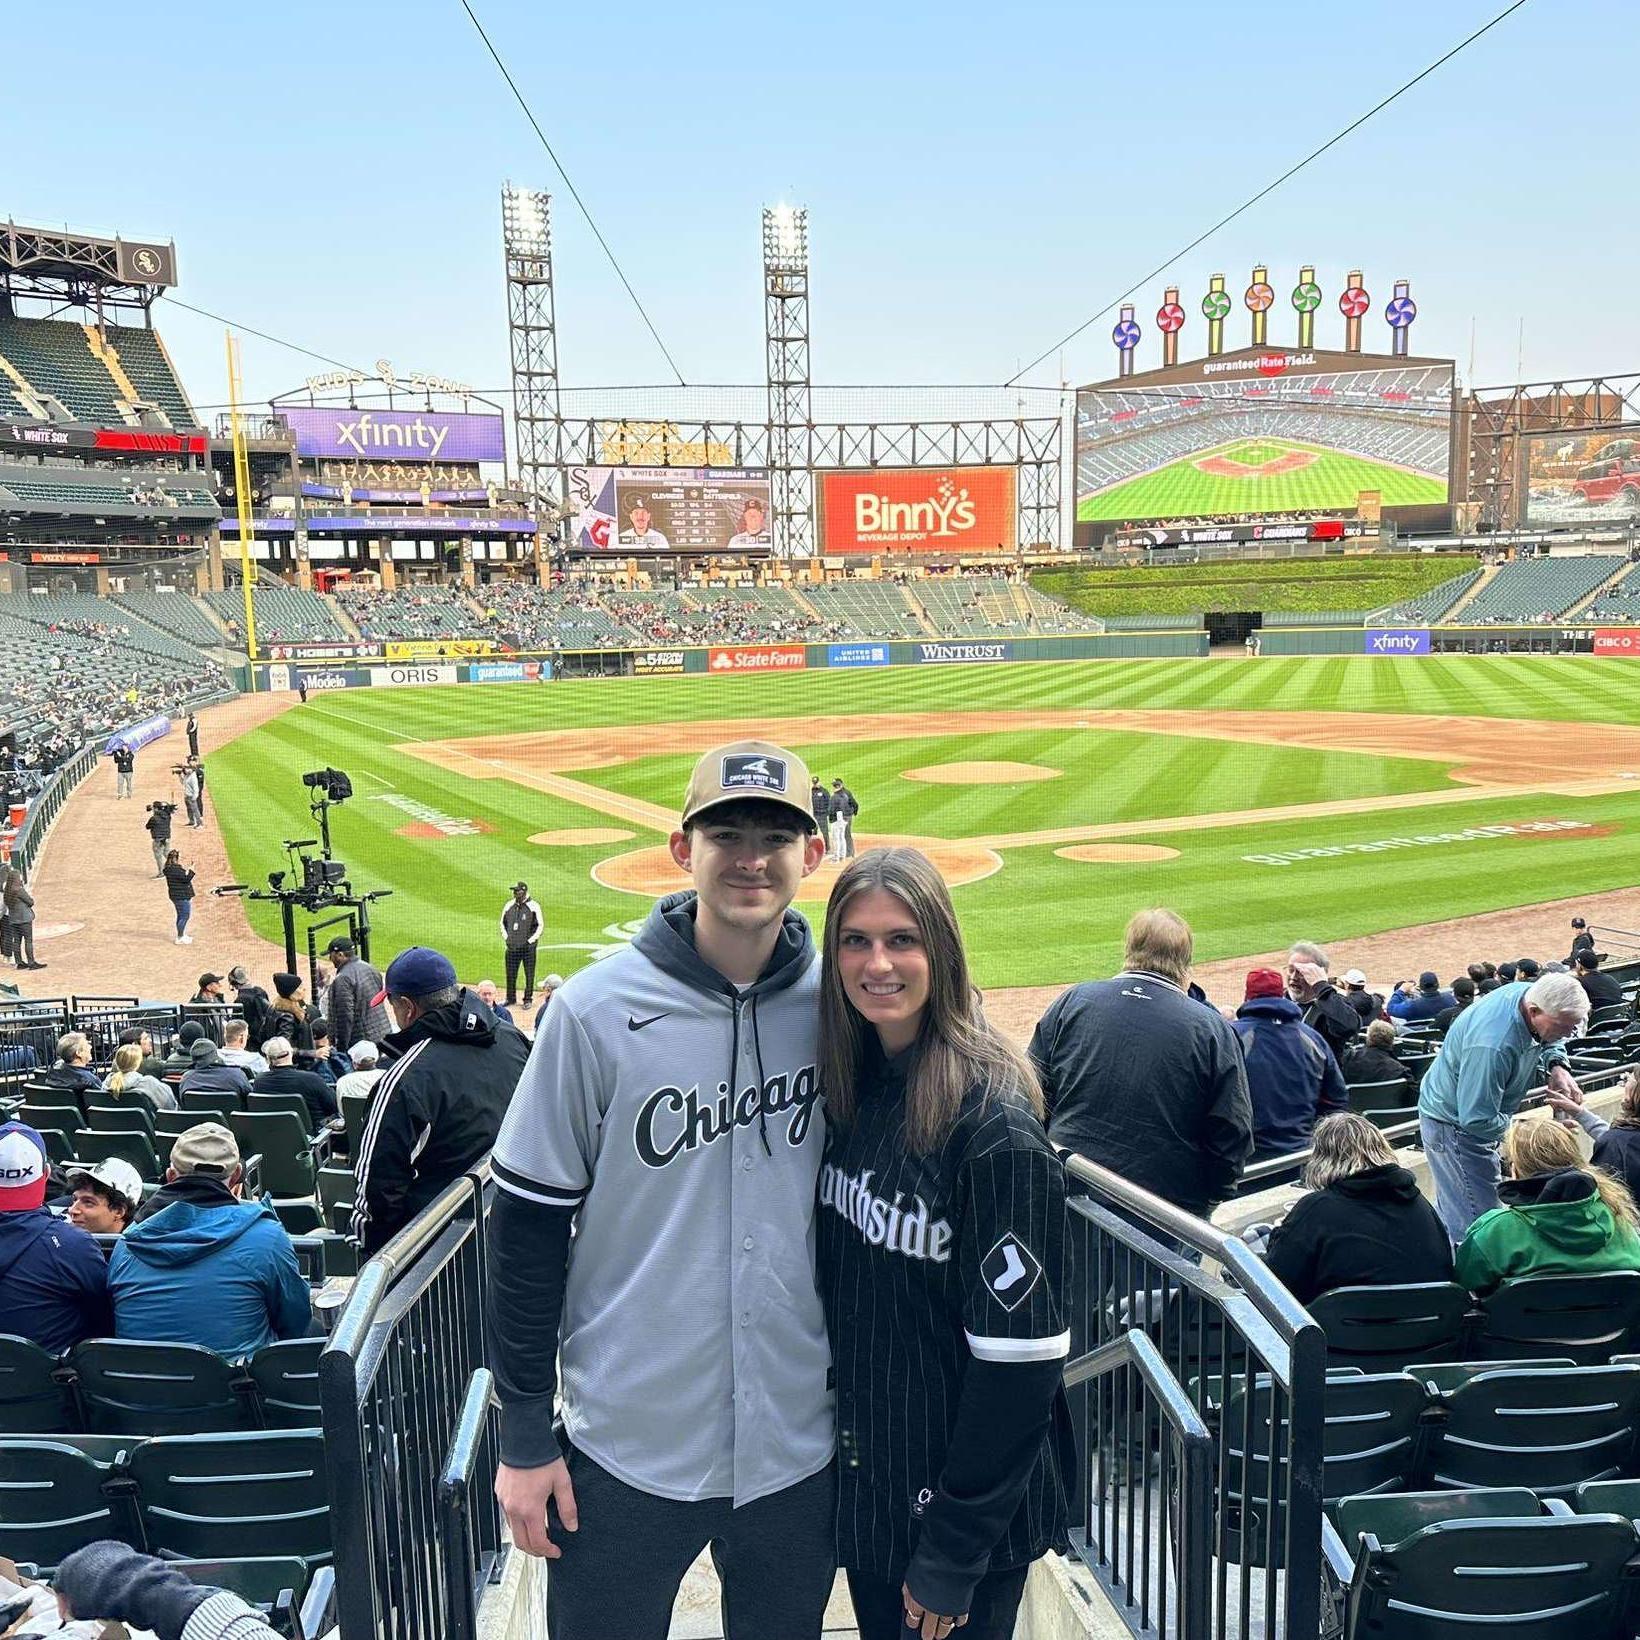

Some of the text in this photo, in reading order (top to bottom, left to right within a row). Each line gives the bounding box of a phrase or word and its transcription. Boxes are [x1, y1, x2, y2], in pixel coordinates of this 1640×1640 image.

[1203, 358, 1260, 374] guaranteed
[1261, 358, 1284, 368] Rate
[306, 371, 364, 393] KIDS
[409, 372, 472, 401] ZONE
[24, 430, 51, 442] WHITE
[51, 432, 69, 443] SOX
[336, 415, 449, 456] xfinity
[857, 532, 927, 542] BEVERAGE DEPOT
[1216, 530, 1233, 541] SOX
[1263, 526, 1308, 539] GUARDIANS
[1373, 634, 1420, 651] xfinity
[1562, 630, 1586, 640] THE
[920, 644, 1006, 659] WINTRUST
[307, 674, 346, 689] Modelo
[391, 668, 439, 684] ORIS
[634, 1063, 827, 1170] Chicag
